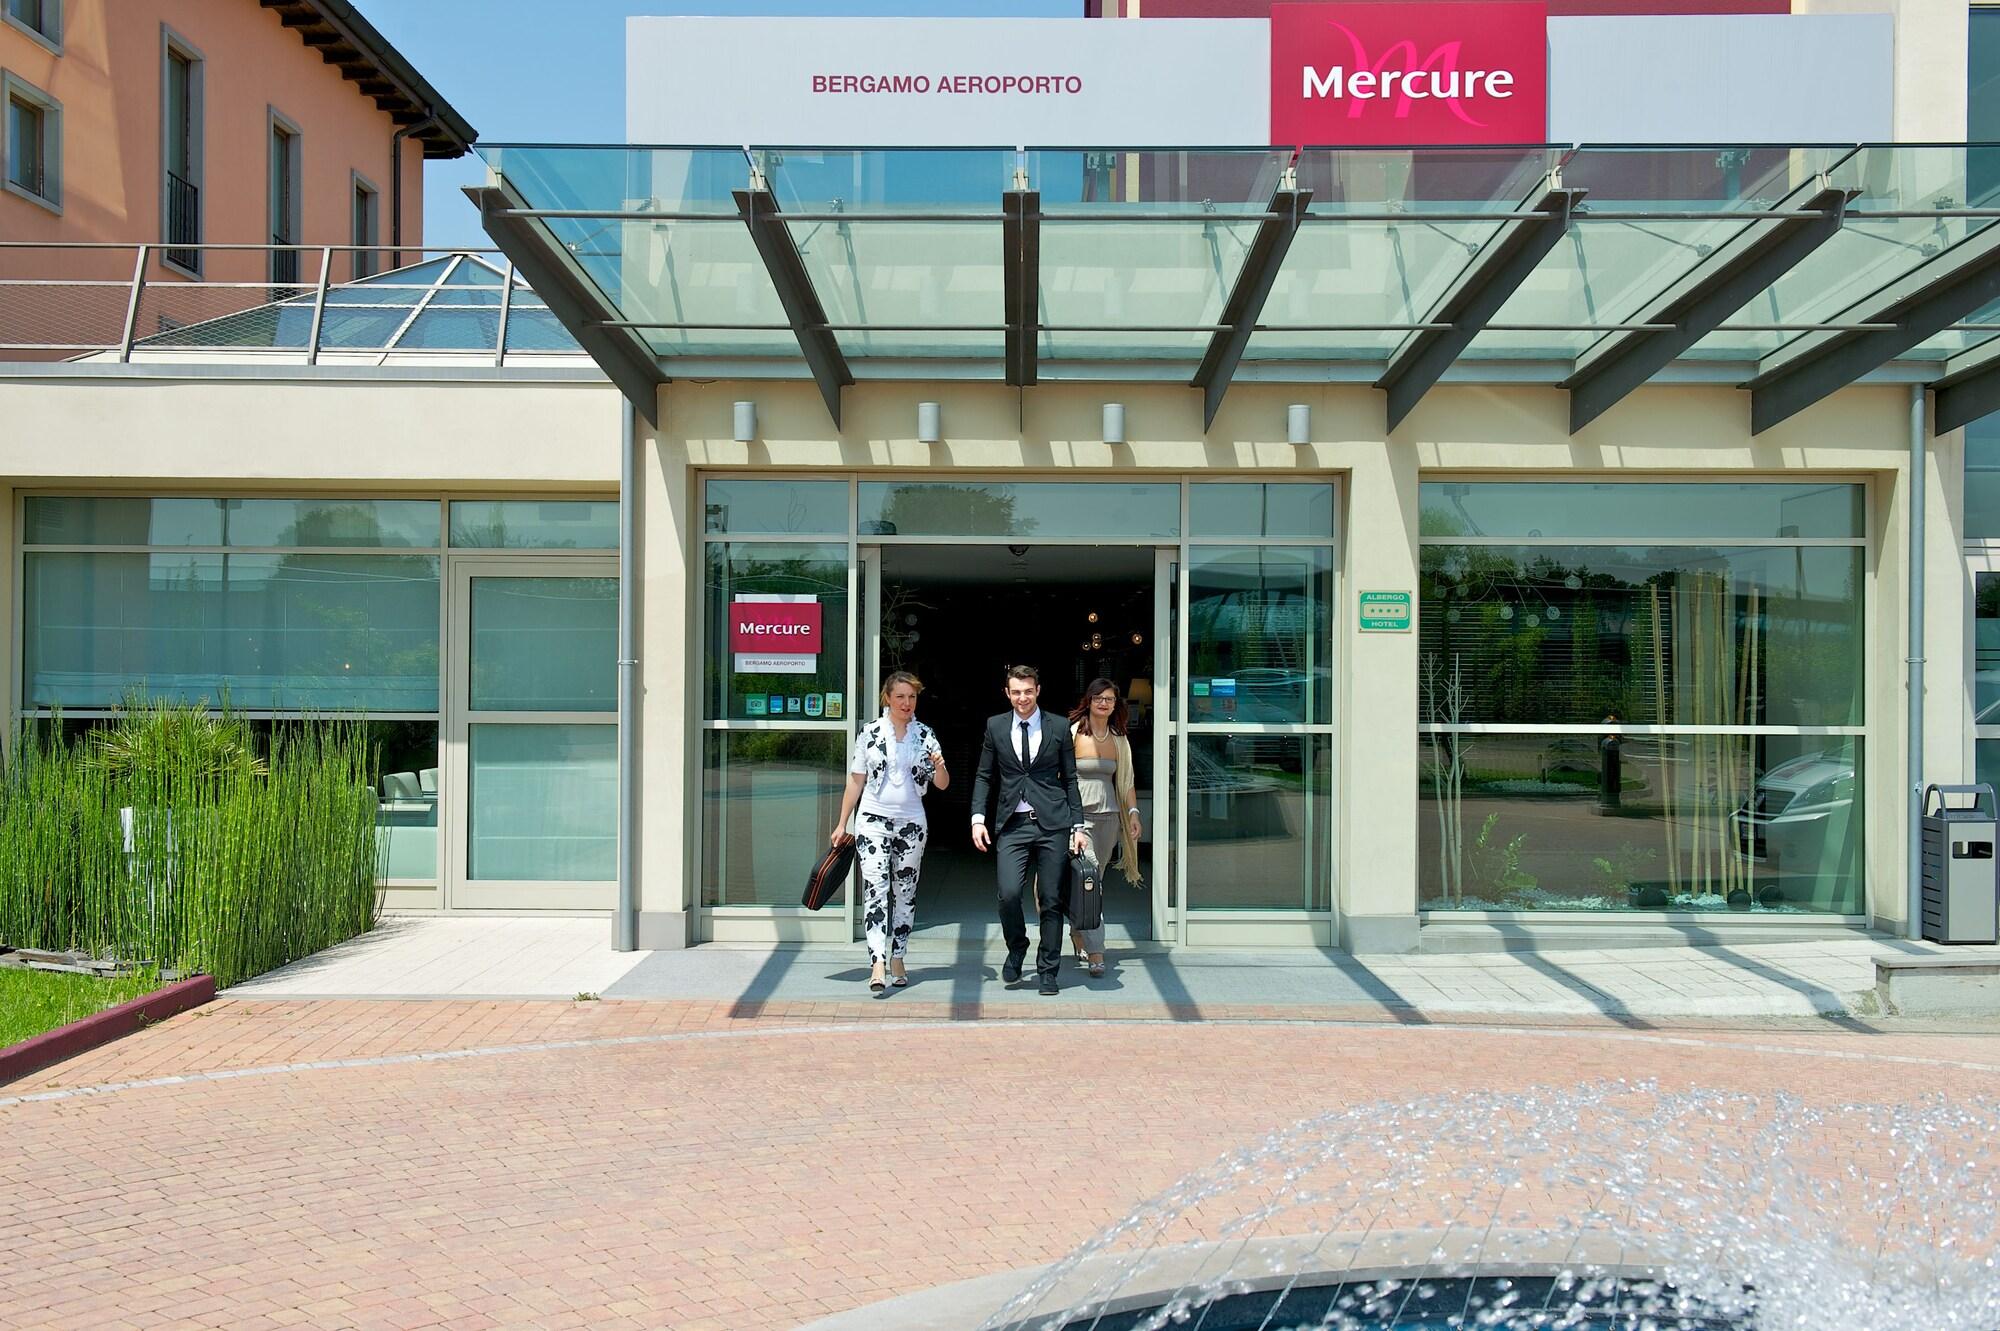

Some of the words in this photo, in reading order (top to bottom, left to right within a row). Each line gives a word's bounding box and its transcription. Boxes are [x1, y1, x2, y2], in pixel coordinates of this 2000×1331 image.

[812, 75, 930, 94] BERGAMO
[936, 76, 1082, 94] AEROPORTO
[1302, 65, 1514, 99] Mercure
[739, 622, 811, 635] Mercure
